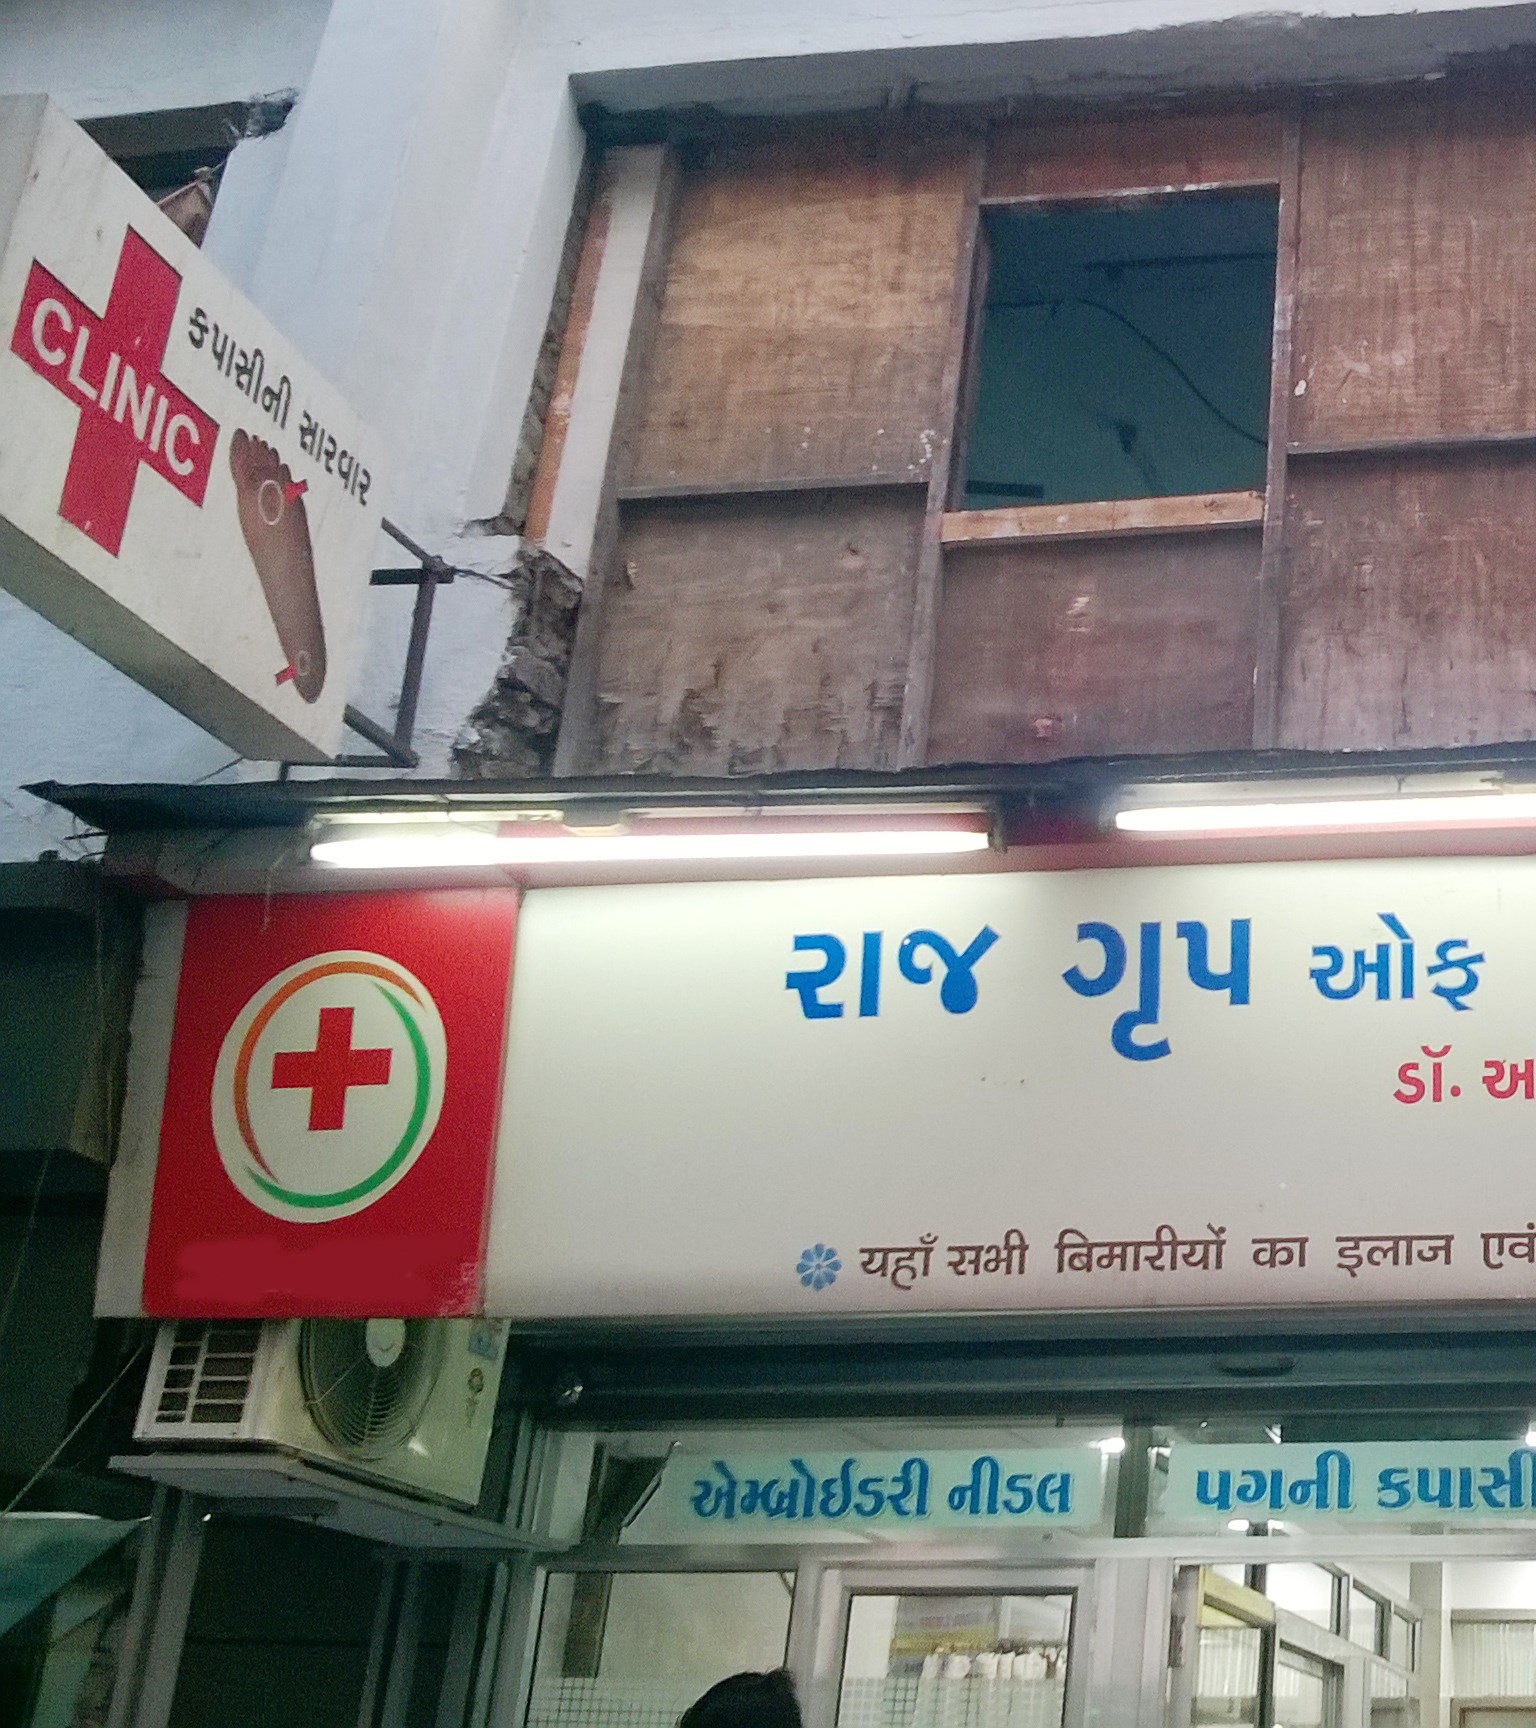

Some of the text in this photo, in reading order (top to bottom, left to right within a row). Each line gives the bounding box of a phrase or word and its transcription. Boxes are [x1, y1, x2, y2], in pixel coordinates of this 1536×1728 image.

[31, 297, 200, 476] CLINIC
[188, 307, 371, 506] કપાસીની સારવાર
[785, 925, 1000, 1020] રાજ
[1061, 919, 1250, 1062] ગૃપ
[1309, 913, 1486, 1012] ઓફ
[859, 1233, 938, 1291] यहाँ
[947, 1229, 1029, 1276] सभी
[1054, 1223, 1226, 1273] बिमारीयों
[1252, 1237, 1309, 1268] का
[1335, 1235, 1454, 1278] इलाज
[946, 1453, 1073, 1518] નીડલ
[1194, 1450, 1356, 1514] પગની
